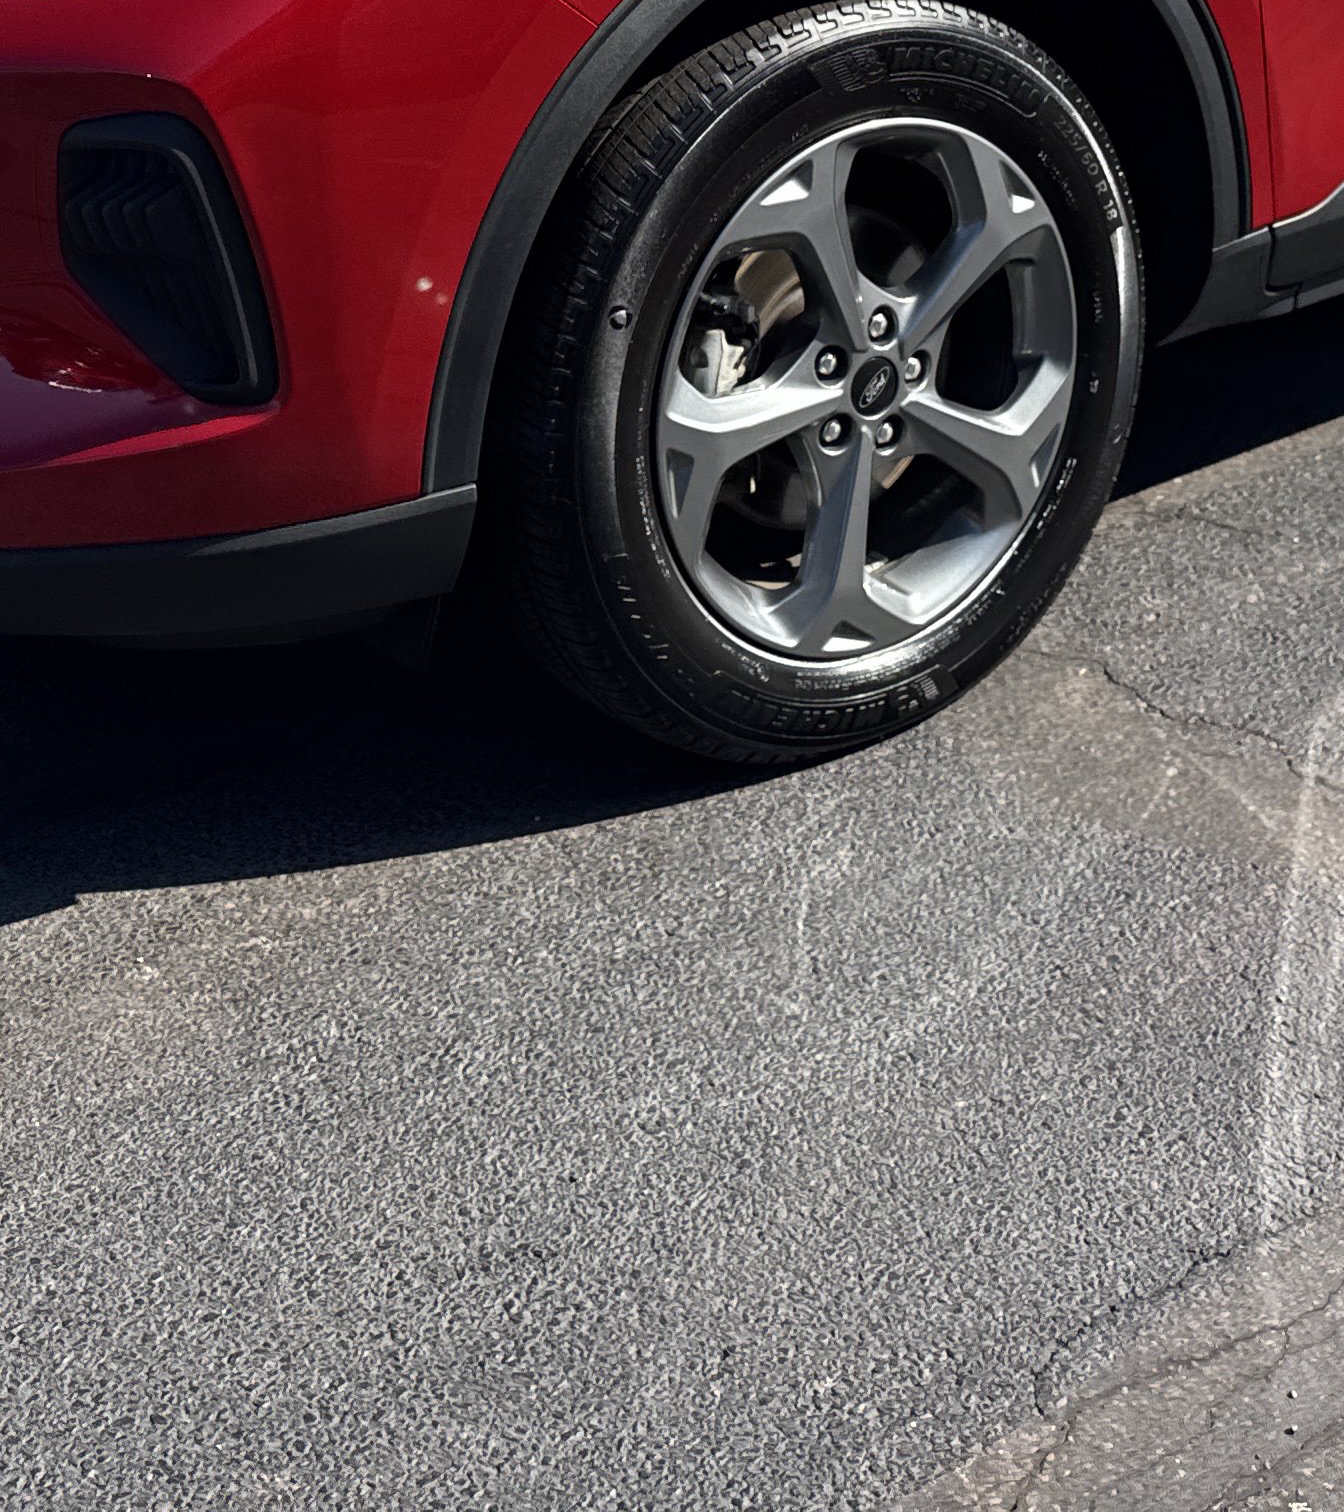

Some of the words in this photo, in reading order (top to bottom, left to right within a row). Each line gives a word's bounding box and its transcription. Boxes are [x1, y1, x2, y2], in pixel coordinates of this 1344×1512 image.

[888, 46, 1042, 114] MICHELIN
[1094, 179, 1108, 196] R
[1102, 199, 1119, 222] 18
